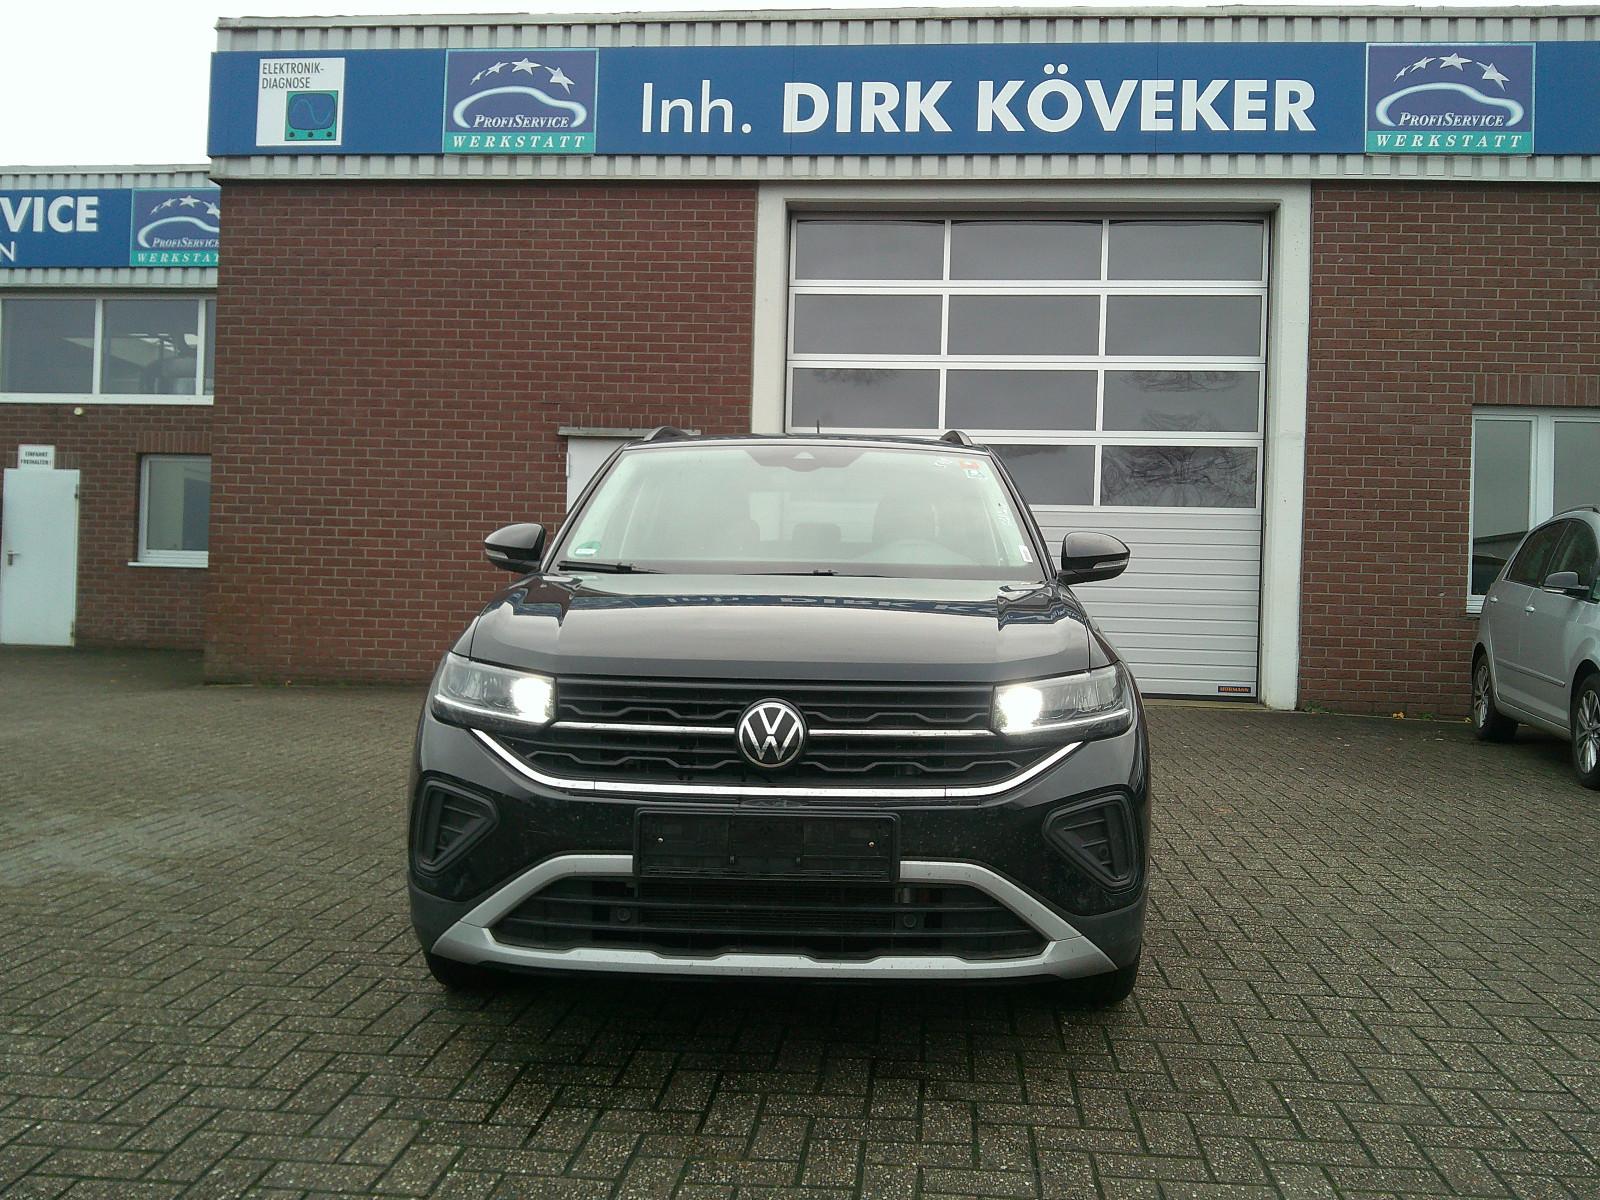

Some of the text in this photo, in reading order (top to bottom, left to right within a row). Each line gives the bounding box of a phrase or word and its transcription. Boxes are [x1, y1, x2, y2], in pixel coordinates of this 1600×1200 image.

[261, 62, 325, 76] ELEKTRONIK-
[261, 76, 311, 90] DIAGNOSE
[641, 63, 1317, 134] Inh. DIRK KÖVEKER
[452, 134, 586, 149] WERKSTATT
[1376, 134, 1522, 148] WERKSTATT
